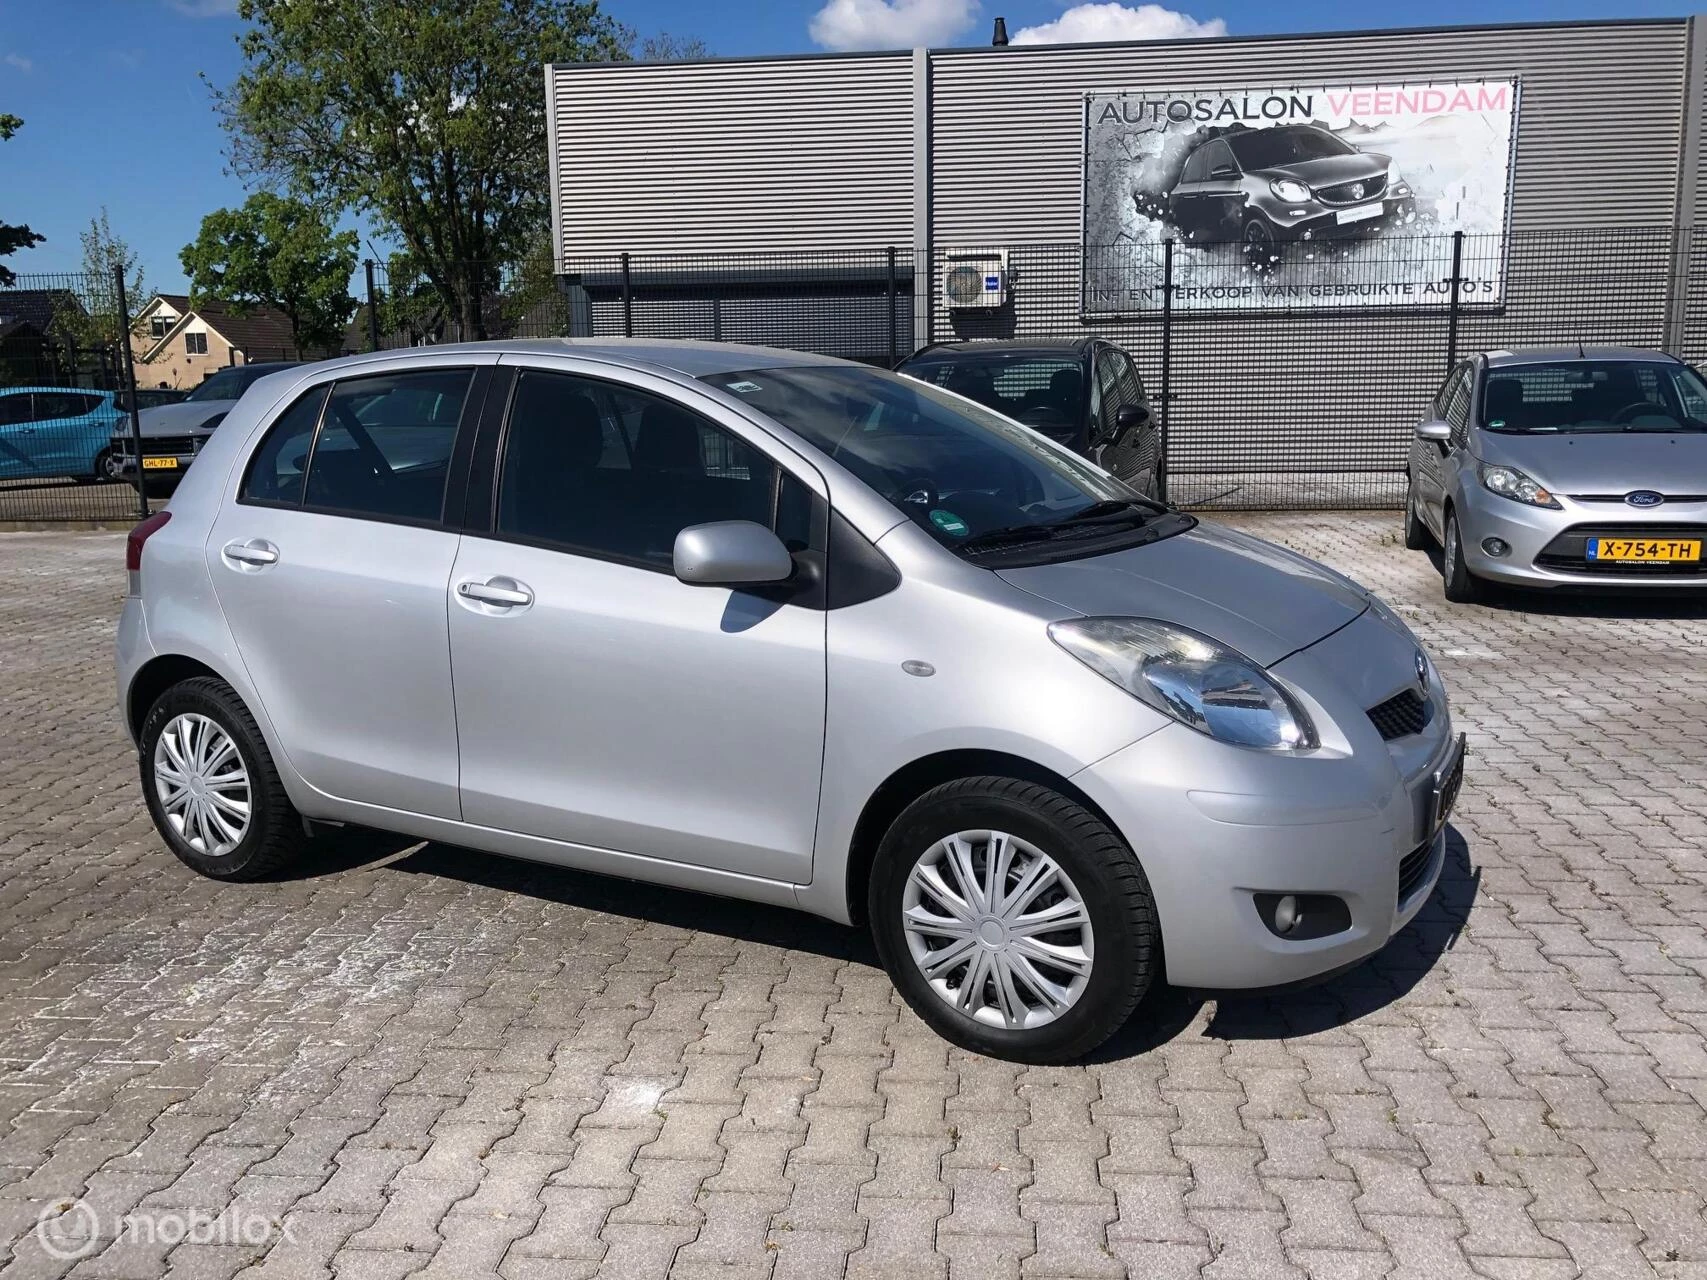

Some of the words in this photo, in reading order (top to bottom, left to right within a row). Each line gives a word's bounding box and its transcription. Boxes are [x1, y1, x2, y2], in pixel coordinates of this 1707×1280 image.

[1097, 96, 1313, 125] AUTOSALON
[1328, 87, 1506, 116] VEENDAM
[1129, 288, 1153, 301] EN
[1163, 286, 1253, 300] ERKOOP
[1261, 285, 1299, 298] VAN
[1308, 282, 1414, 297] GEBRUIKTE
[1423, 277, 1494, 295] AUO'S
[1633, 495, 1655, 503] Ford
[1603, 541, 1692, 558] X-754-TH
